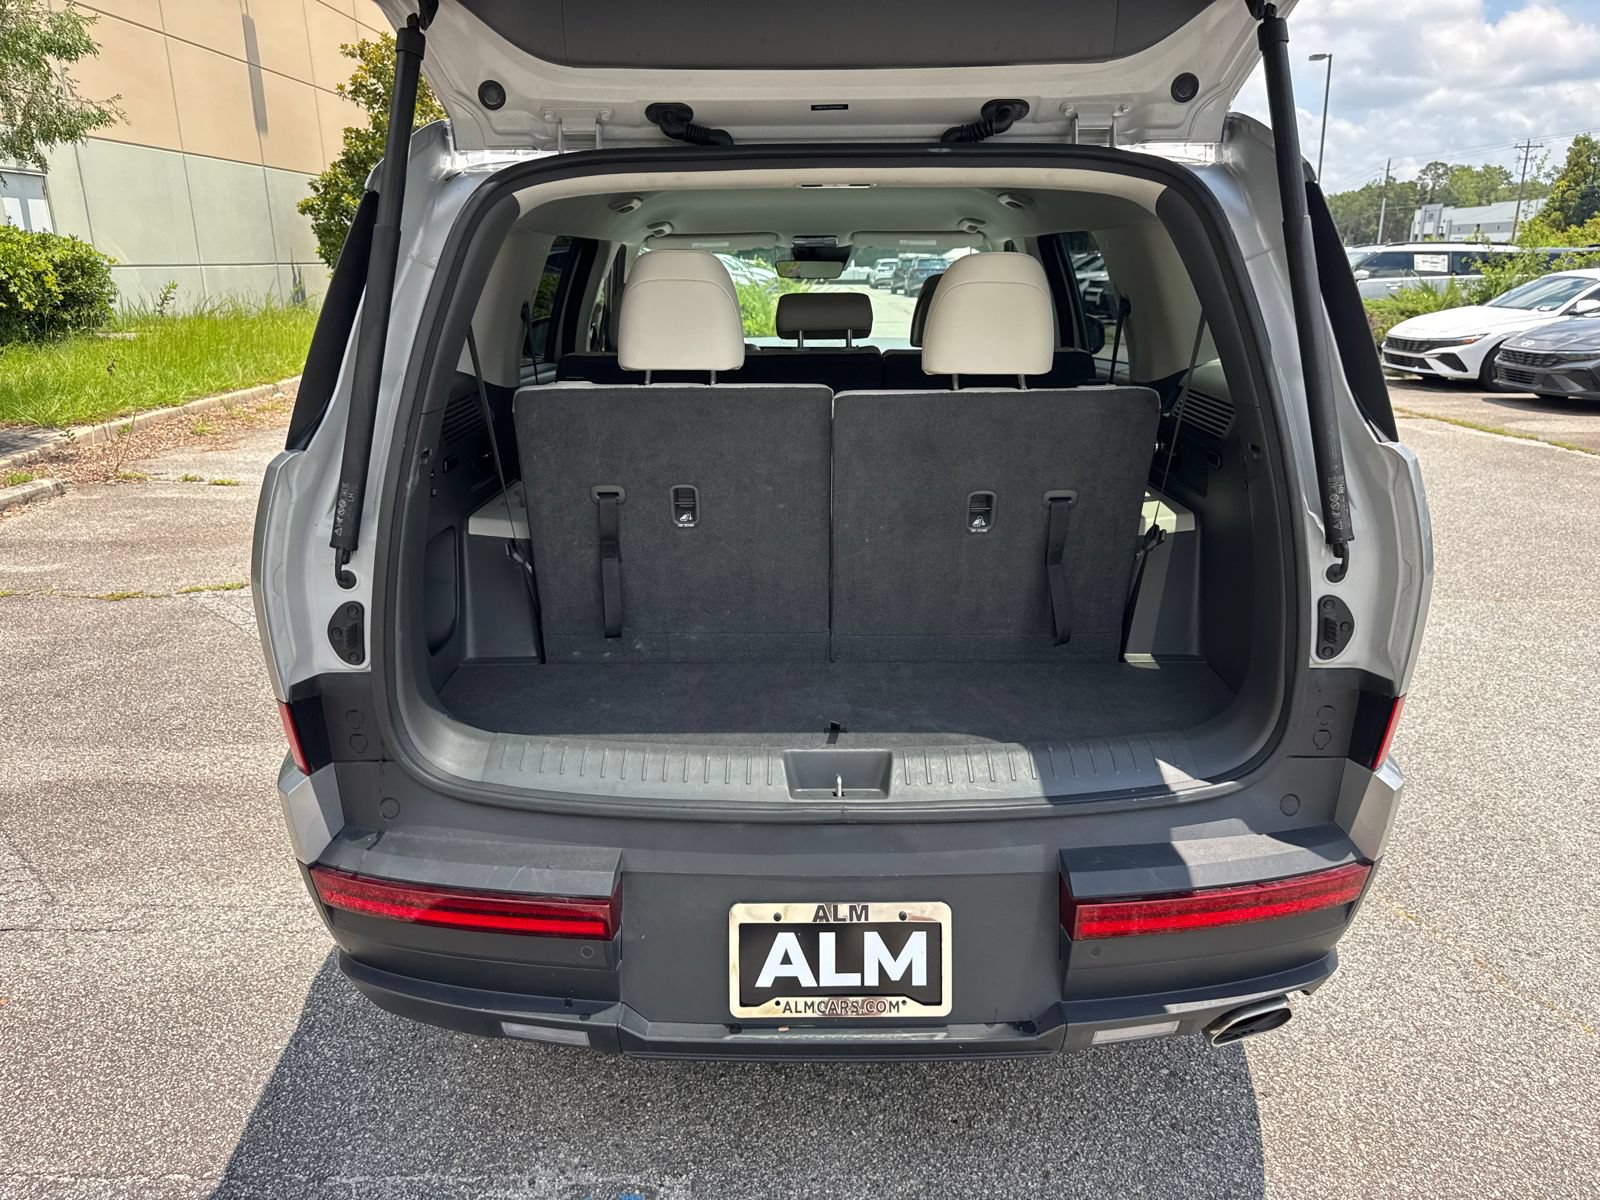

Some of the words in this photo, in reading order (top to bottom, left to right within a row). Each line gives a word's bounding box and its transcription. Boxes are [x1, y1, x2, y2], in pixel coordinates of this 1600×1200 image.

[812, 904, 869, 922] ALM
[755, 931, 927, 987] ALM
[782, 1000, 900, 1015] ALMCARS.COM
